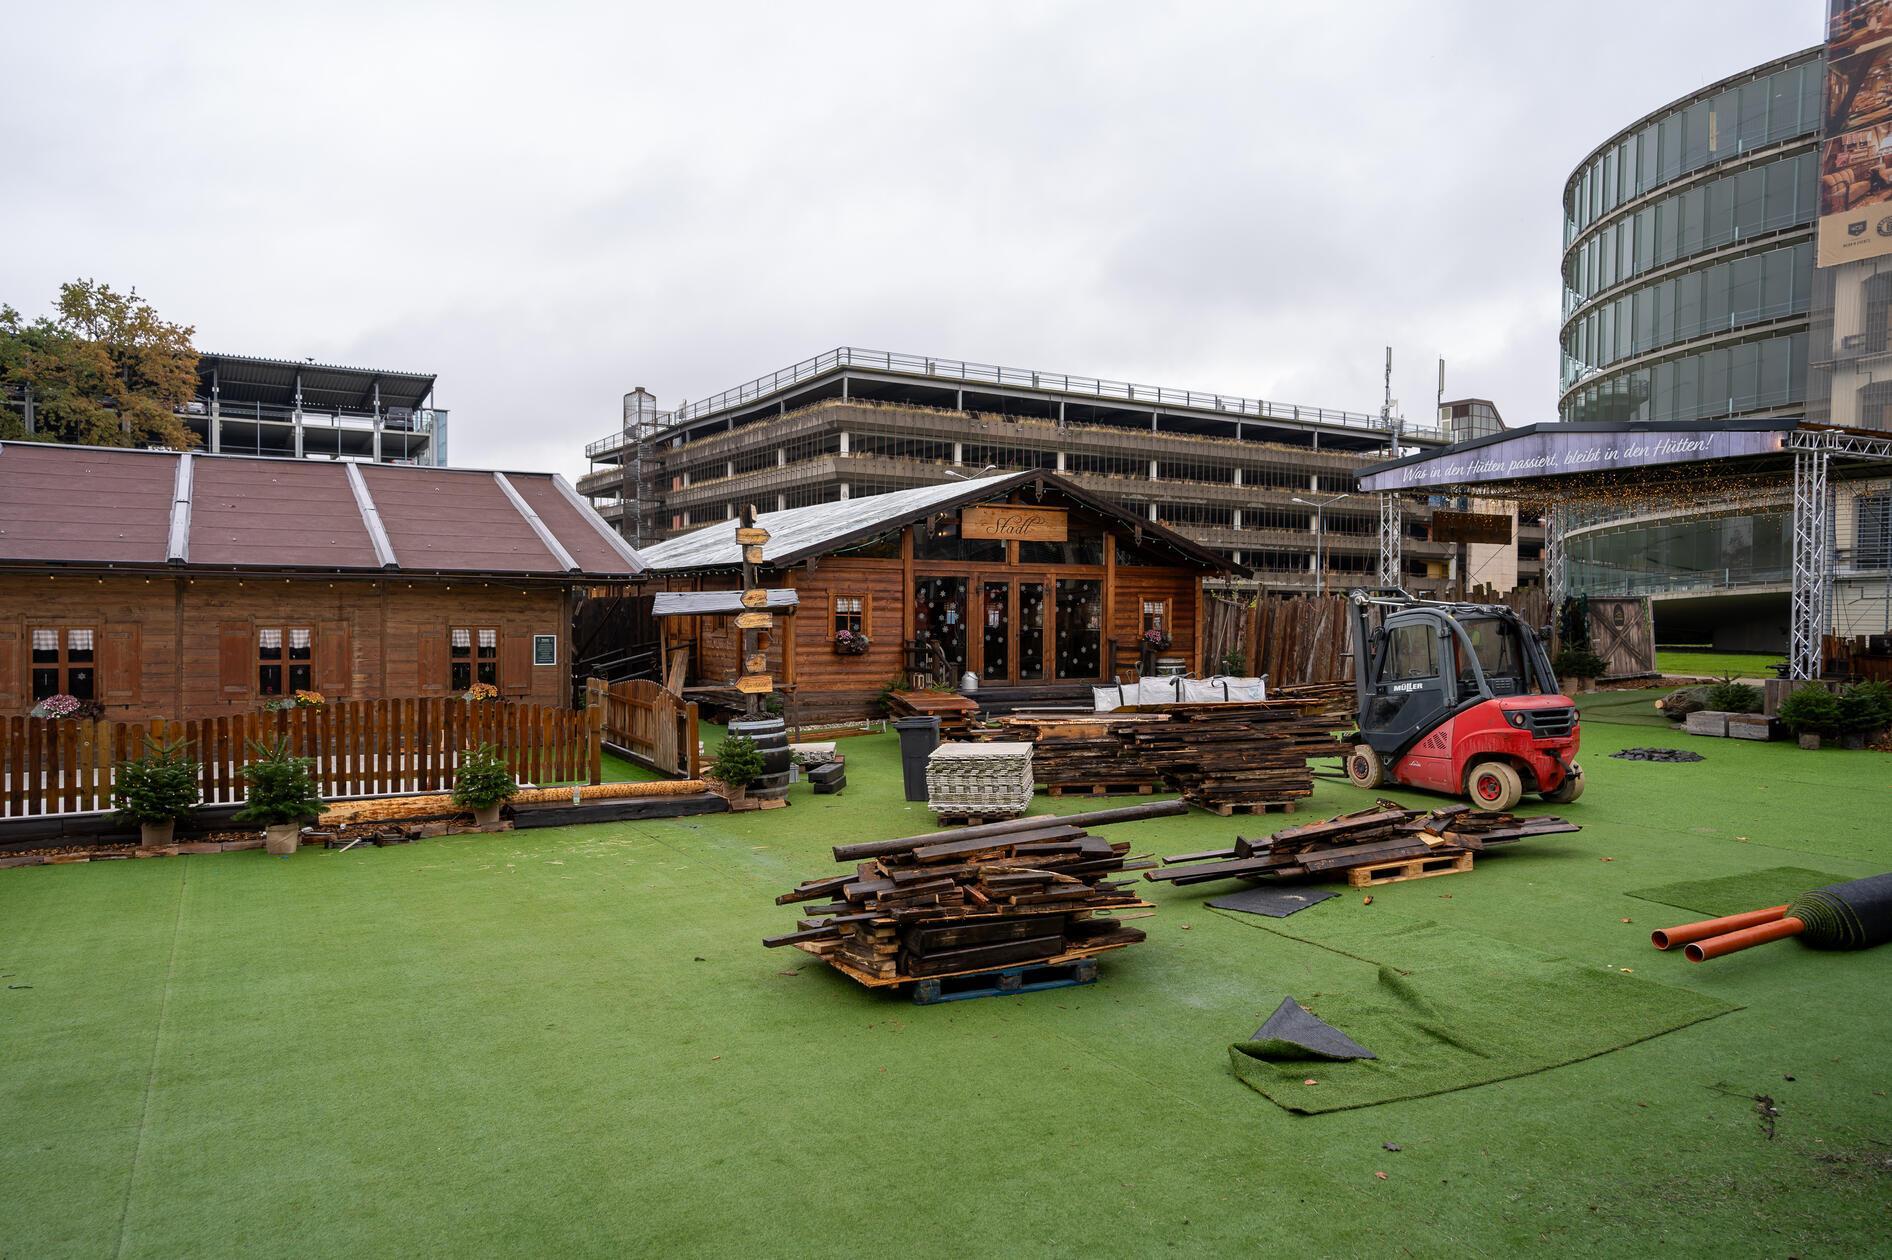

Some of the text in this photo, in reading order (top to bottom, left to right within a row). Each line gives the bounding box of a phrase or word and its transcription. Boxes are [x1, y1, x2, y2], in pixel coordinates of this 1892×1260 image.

[1402, 433, 1714, 482] Was in den Hütten passiert, bleibt in den Hütten!
[985, 514, 1047, 535] Stadl
